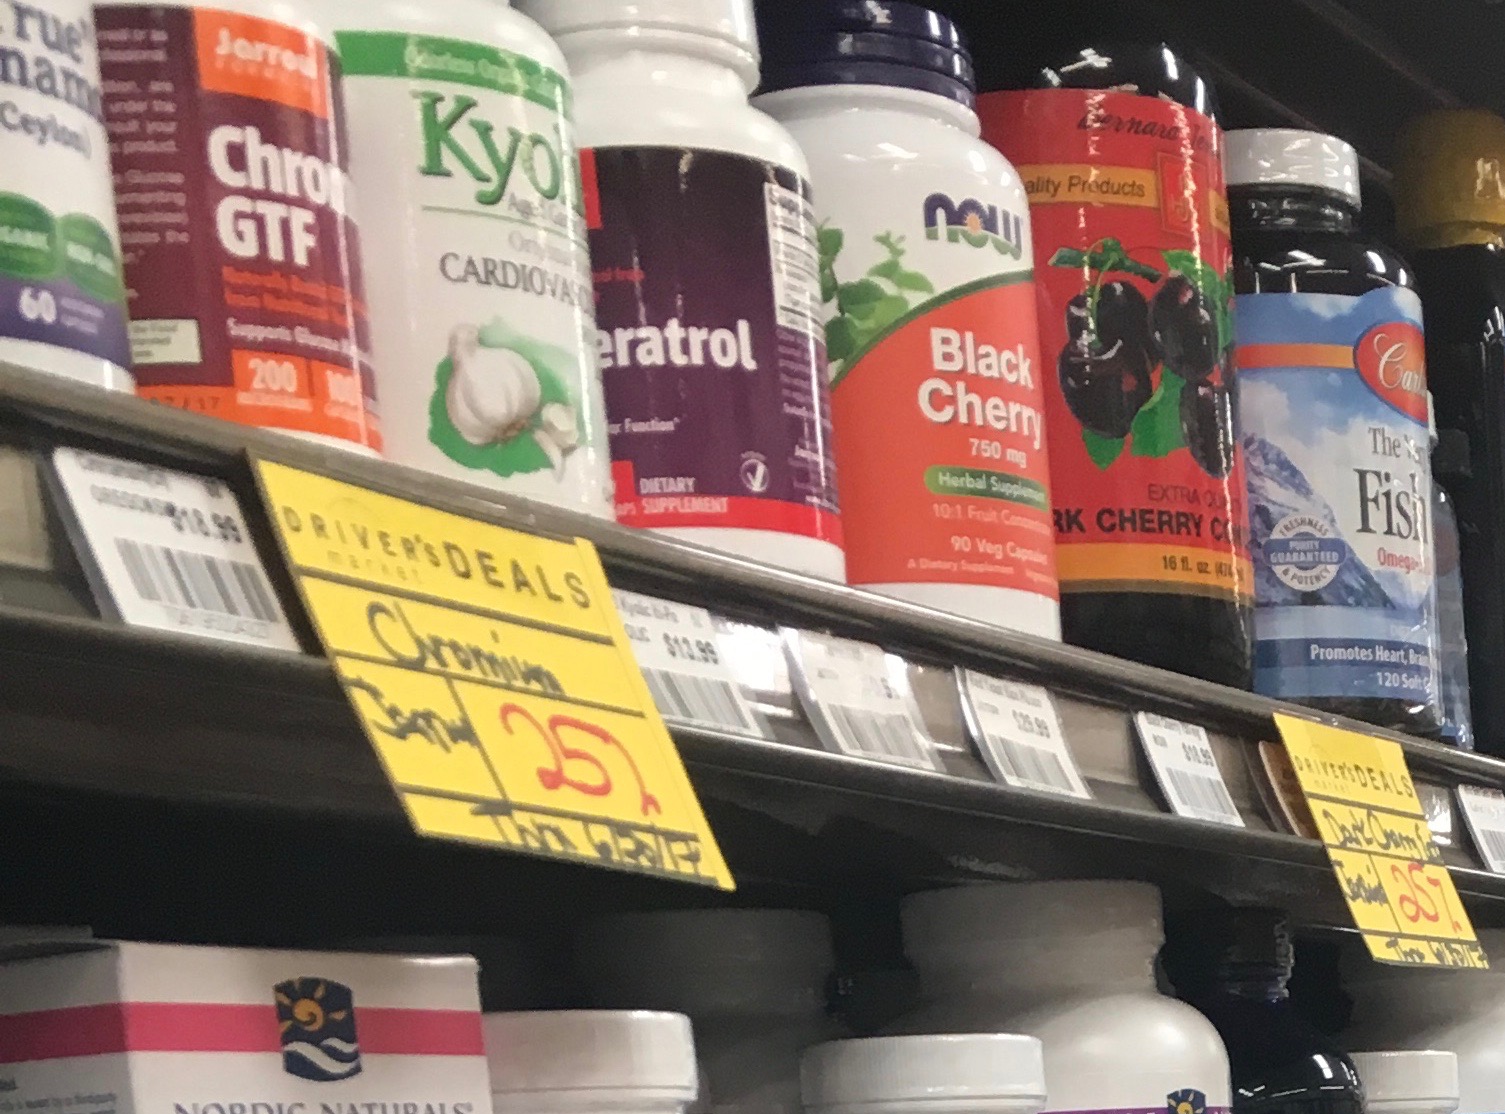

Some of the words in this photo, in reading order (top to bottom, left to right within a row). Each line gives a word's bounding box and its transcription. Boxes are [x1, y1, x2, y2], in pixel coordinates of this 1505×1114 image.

[1067, 175, 1145, 198] Products
[215, 195, 317, 267] GTF
[19, 285, 56, 325] 60
[930, 326, 1033, 391] Black
[249, 358, 297, 392] 200
[918, 376, 1042, 450] Cherry
[968, 438, 1001, 459] 750
[1368, 427, 1400, 456] The
[640, 477, 695, 494] DIETARY
[938, 471, 987, 490] Herbal
[641, 497, 729, 514] SUPPLEMENT
[1353, 468, 1429, 545] Fish
[1096, 508, 1201, 538] CHERRY
[1280, 514, 1329, 537] FRESHNESS
[951, 535, 971, 552] 90
[975, 538, 1003, 559] Veg
[1270, 551, 1339, 563] GUARANTEED
[444, 540, 590, 608] DEALS
[1310, 644, 1373, 661] Promotes
[1375, 646, 1407, 666] Heart,
[1377, 671, 1399, 688] 120
[1355, 764, 1414, 798] DEALS
